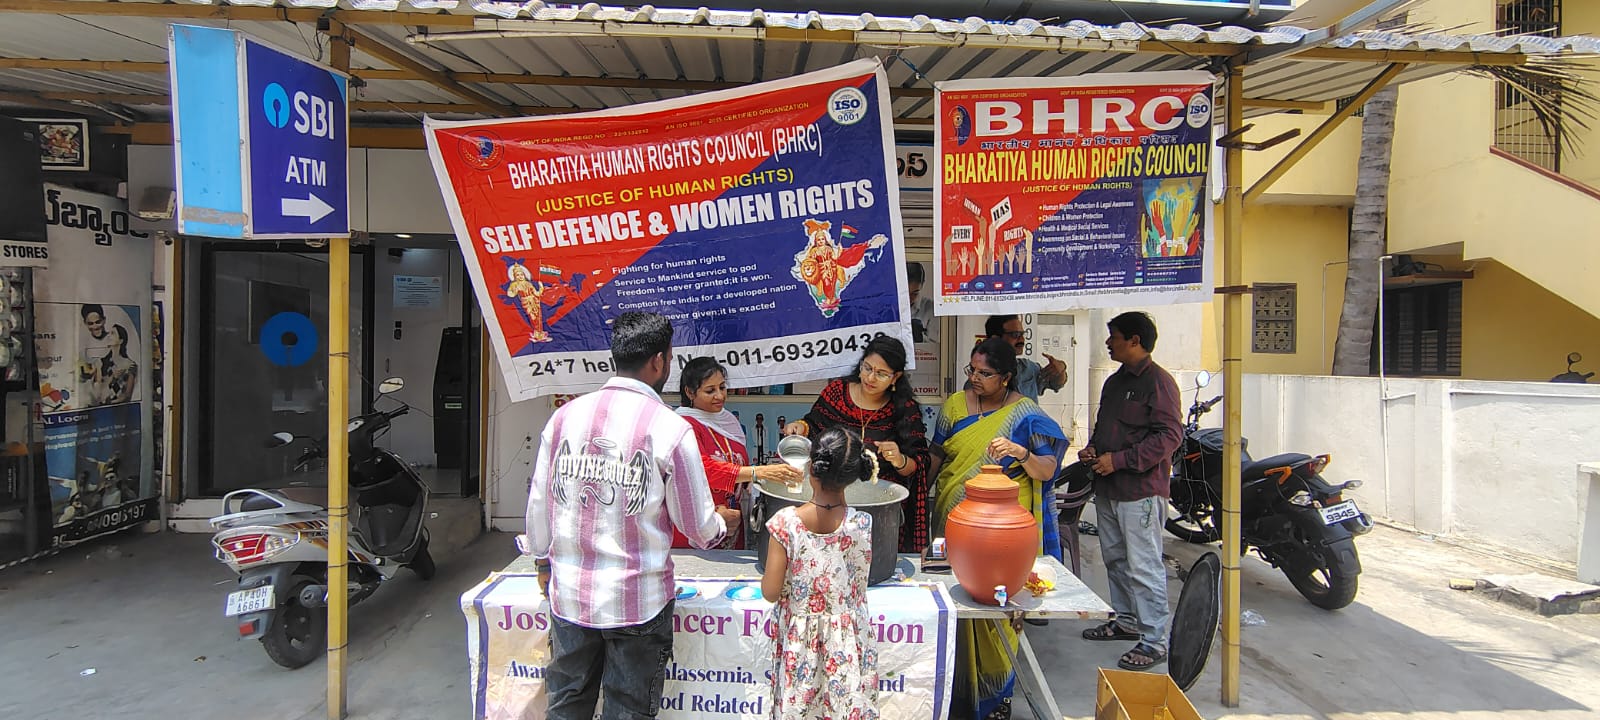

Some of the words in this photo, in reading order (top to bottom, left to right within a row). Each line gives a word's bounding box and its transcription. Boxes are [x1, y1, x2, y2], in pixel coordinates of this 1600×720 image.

[724, 111, 758, 121] CERTIFIED
[759, 102, 809, 116] ORGANIZATION
[835, 99, 860, 110] ISO
[1190, 105, 1208, 114] ISO
[294, 91, 334, 140] SBI
[838, 113, 859, 121] 9001
[975, 95, 1184, 136] BHRC
[508, 155, 591, 190] BHARATIYA
[591, 147, 646, 178] HUMAN
[649, 139, 701, 172] RIGHTS
[704, 129, 770, 164] COUNCIL
[772, 122, 823, 162] (BHRC)
[944, 150, 1028, 185] BHARATIYA
[1031, 147, 1087, 181] HUMAN
[1091, 145, 1143, 178] RIGHTS
[1145, 143, 1208, 177] COUNCIL
[285, 155, 326, 187] ATM
[535, 191, 615, 217] (JUSTICE
[619, 187, 644, 203] OF
[649, 178, 716, 199] HUMAN
[721, 167, 795, 189] RIGHTS)
[1022, 184, 1058, 194] (JUSTICE
[1072, 183, 1100, 191] HUMAN
[1102, 181, 1133, 190] RIGHTS)
[480, 223, 533, 254] SELF
[535, 209, 645, 250] DEFENCE
[647, 210, 669, 236] &
[670, 192, 775, 233] WOMEN
[778, 179, 875, 220] RIGHTS
[993, 202, 1010, 221] HAS
[1059, 203, 1073, 211] Rights
[1100, 201, 1111, 209] Legal
[953, 228, 971, 239] EVERY
[3, 245, 48, 259] STORES
[612, 263, 649, 276] Fighting
[650, 262, 664, 271] for
[665, 258, 697, 269] human
[699, 254, 726, 265] rights
[614, 278, 646, 288] Service
[647, 276, 657, 284] to
[658, 271, 695, 282] Mankind
[696, 267, 728, 278] service
[729, 265, 739, 274] to
[740, 263, 757, 275] god
[616, 287, 655, 297] Freedom
[656, 285, 666, 293] is
[667, 282, 693, 293] never
[740, 275, 749, 283] is
[750, 273, 773, 282] won.
[660, 297, 677, 306] free
[701, 293, 714, 302] for
[715, 292, 722, 300] a
[723, 286, 768, 300] developed
[769, 284, 797, 294] nation
[664, 311, 690, 320] never
[728, 306, 737, 314] is
[739, 301, 776, 313] exacted
[583, 357, 616, 374] hel
[1326, 508, 1355, 522] 9345
[498, 605, 548, 631] Jos
[673, 613, 731, 635] ncer
[692, 694, 762, 715] Related
